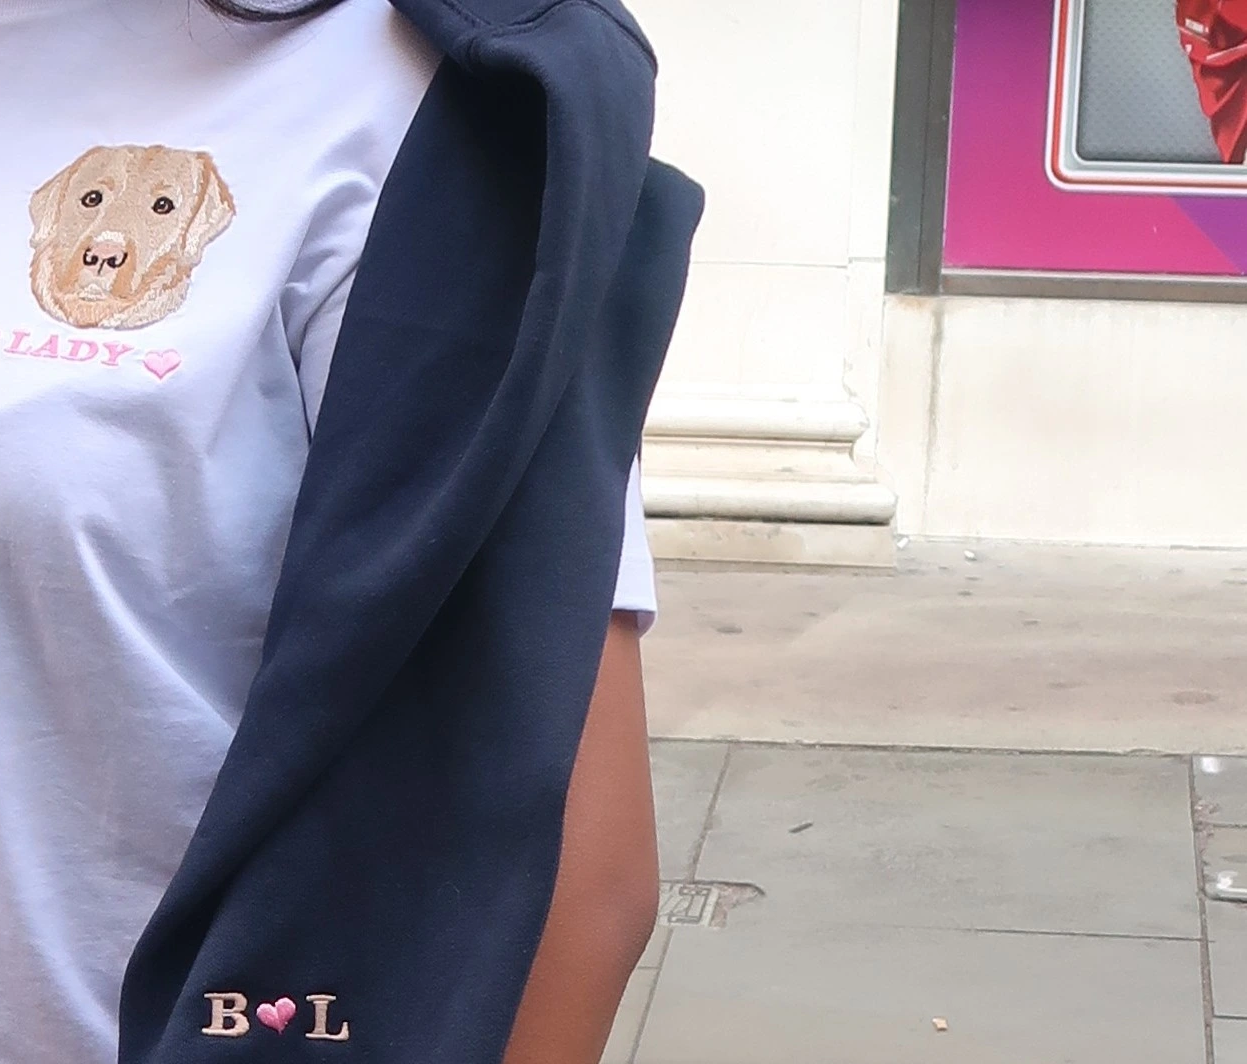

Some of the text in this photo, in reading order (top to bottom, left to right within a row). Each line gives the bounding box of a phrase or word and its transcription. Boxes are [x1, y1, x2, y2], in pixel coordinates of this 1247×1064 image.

[4, 329, 134, 366] LADY
[201, 992, 350, 1041] B L
